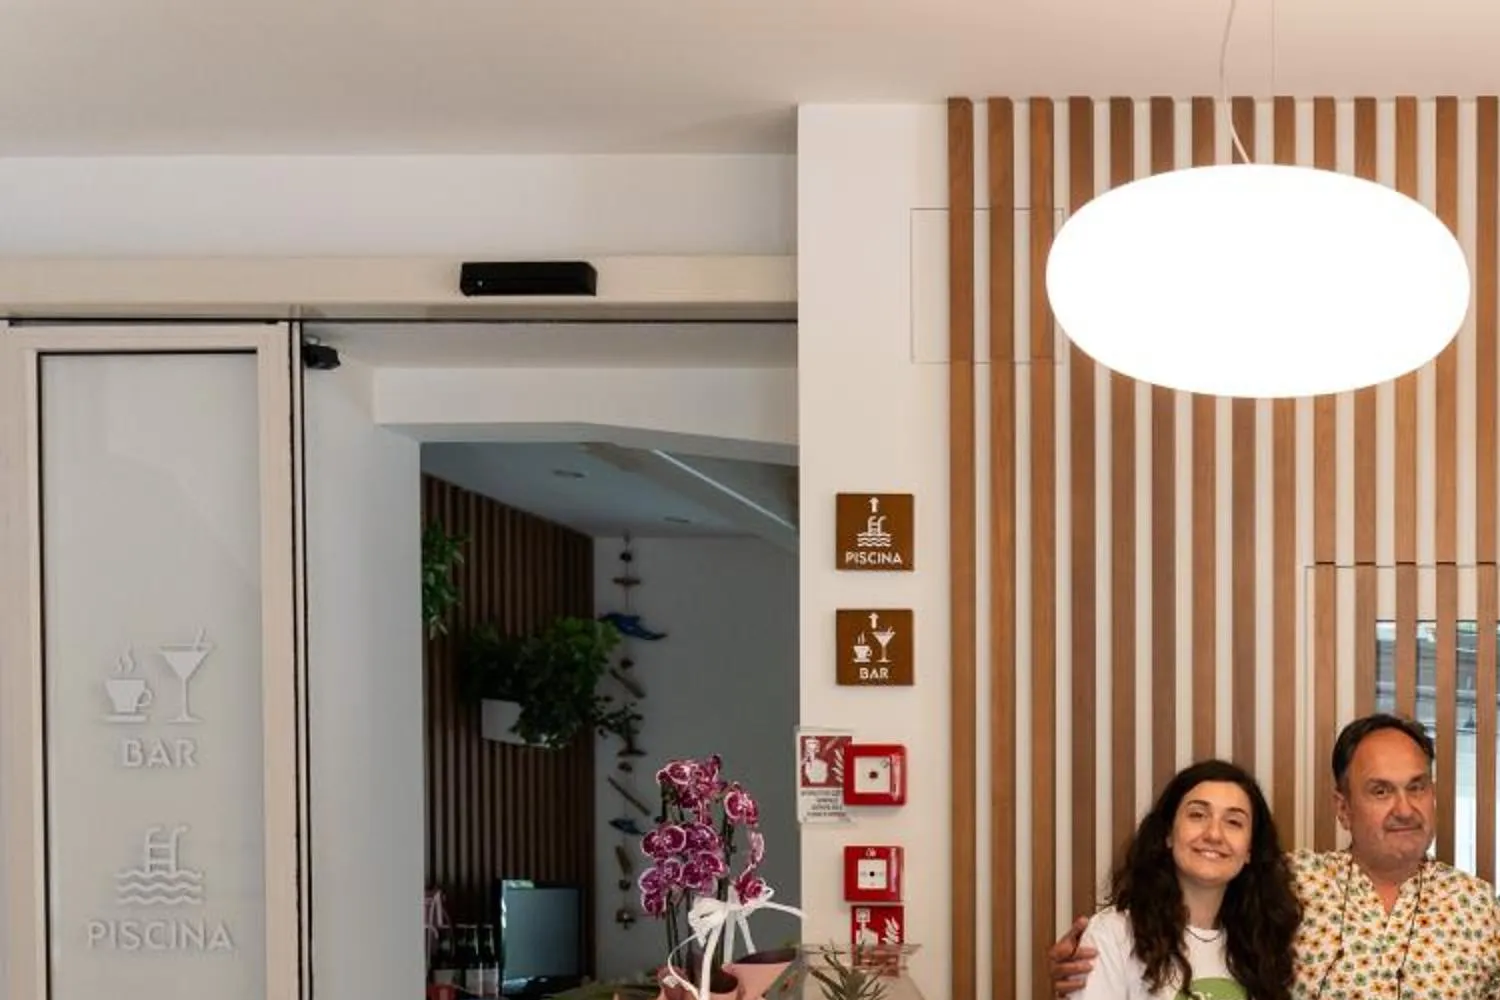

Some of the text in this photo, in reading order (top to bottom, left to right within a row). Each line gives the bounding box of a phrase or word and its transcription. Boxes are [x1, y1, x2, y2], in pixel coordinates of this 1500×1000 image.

[845, 552, 902, 565] PISCINA
[859, 667, 889, 679] BAR
[123, 740, 198, 769] BAR
[87, 920, 235, 950] PISCINA
